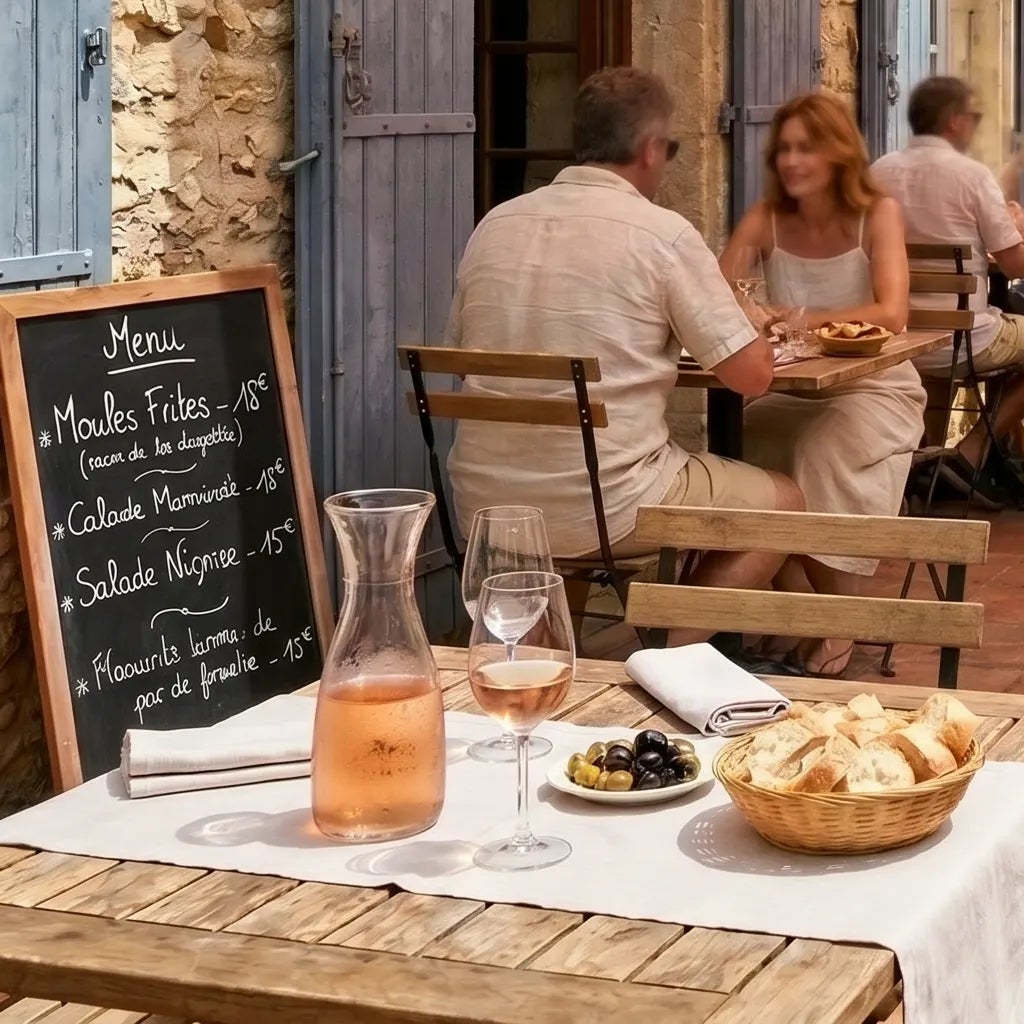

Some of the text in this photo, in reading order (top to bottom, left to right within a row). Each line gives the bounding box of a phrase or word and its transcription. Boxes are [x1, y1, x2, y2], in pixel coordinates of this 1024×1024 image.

[103, 314, 186, 362] Menu
[53, 390, 139, 445] Moules
[144, 382, 211, 426] Frites
[232, 372, 269, 413] 18€
[256, 457, 286, 495] 18€
[76, 556, 159, 608] Salade
[259, 517, 296, 556] 15€
[253, 607, 278, 637] de
[133, 687, 165, 725] par
[171, 672, 193, 699] de
